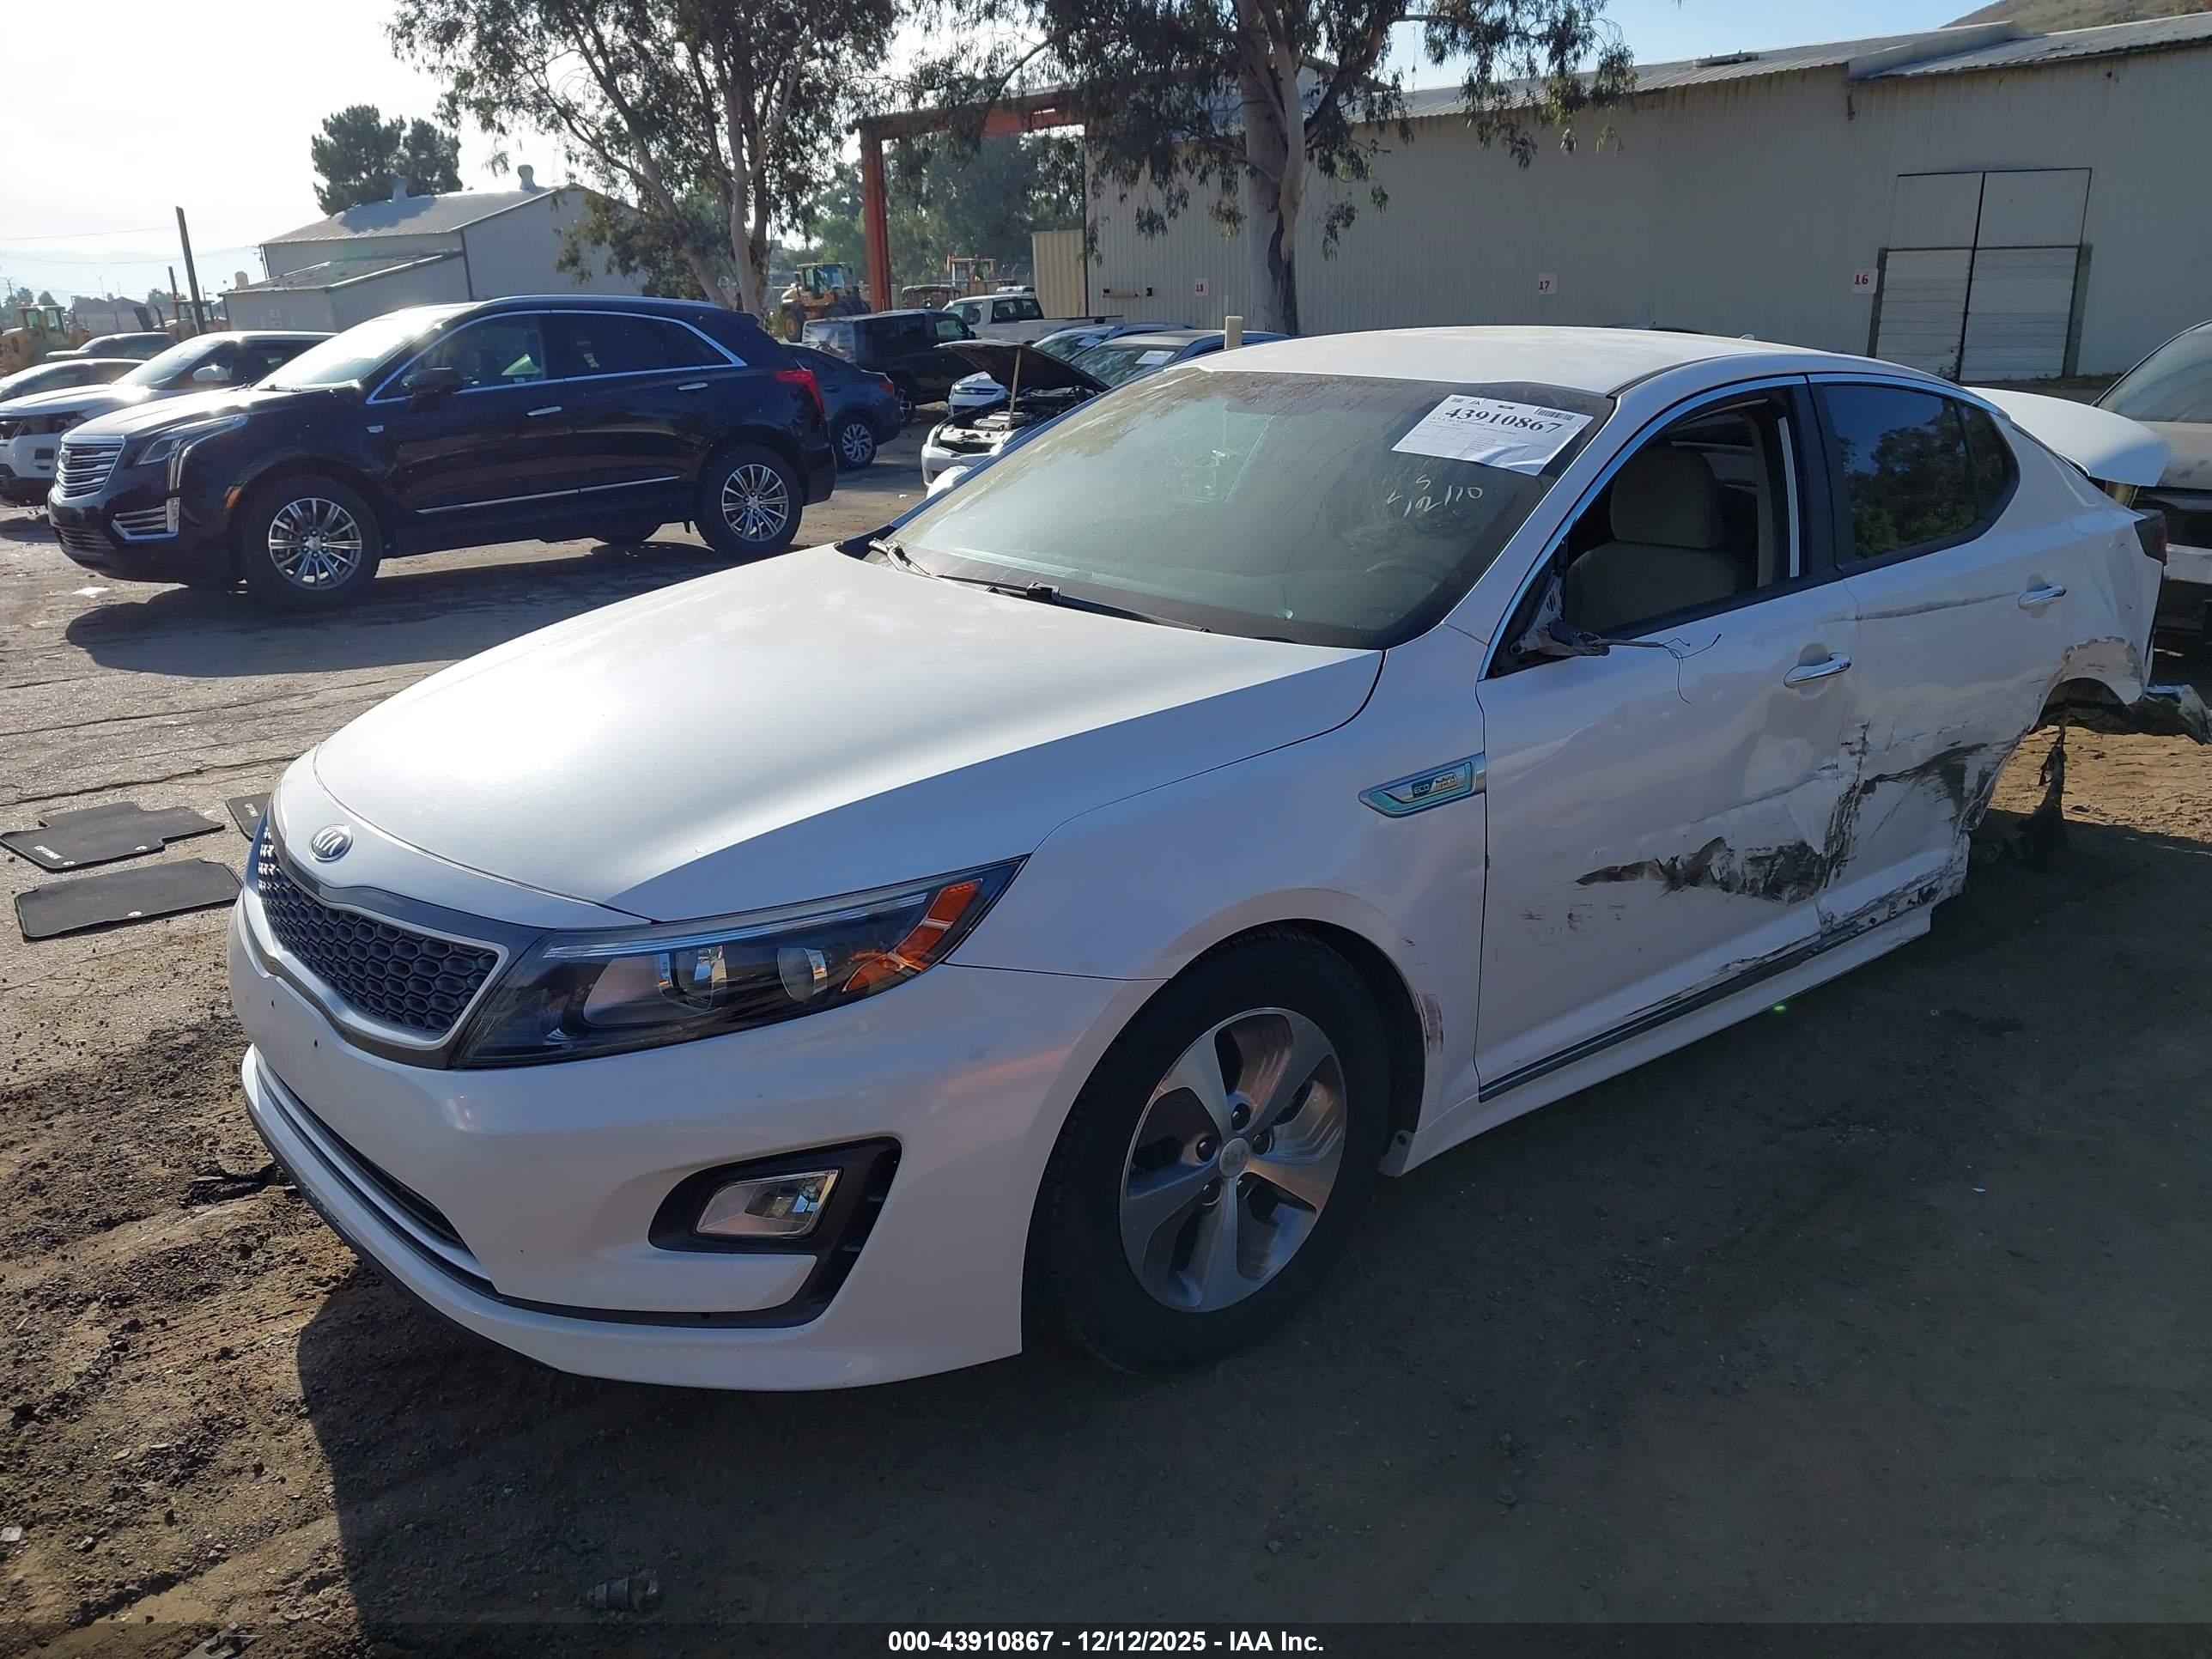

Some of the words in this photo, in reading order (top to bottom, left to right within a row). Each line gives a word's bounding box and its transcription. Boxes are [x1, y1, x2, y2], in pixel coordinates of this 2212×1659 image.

[1855, 274, 1869, 284] 16
[1539, 280, 1550, 291] 17
[1444, 408, 1564, 434] 43910867
[1413, 783, 1430, 794] ECO
[313, 828, 344, 856] KIA
